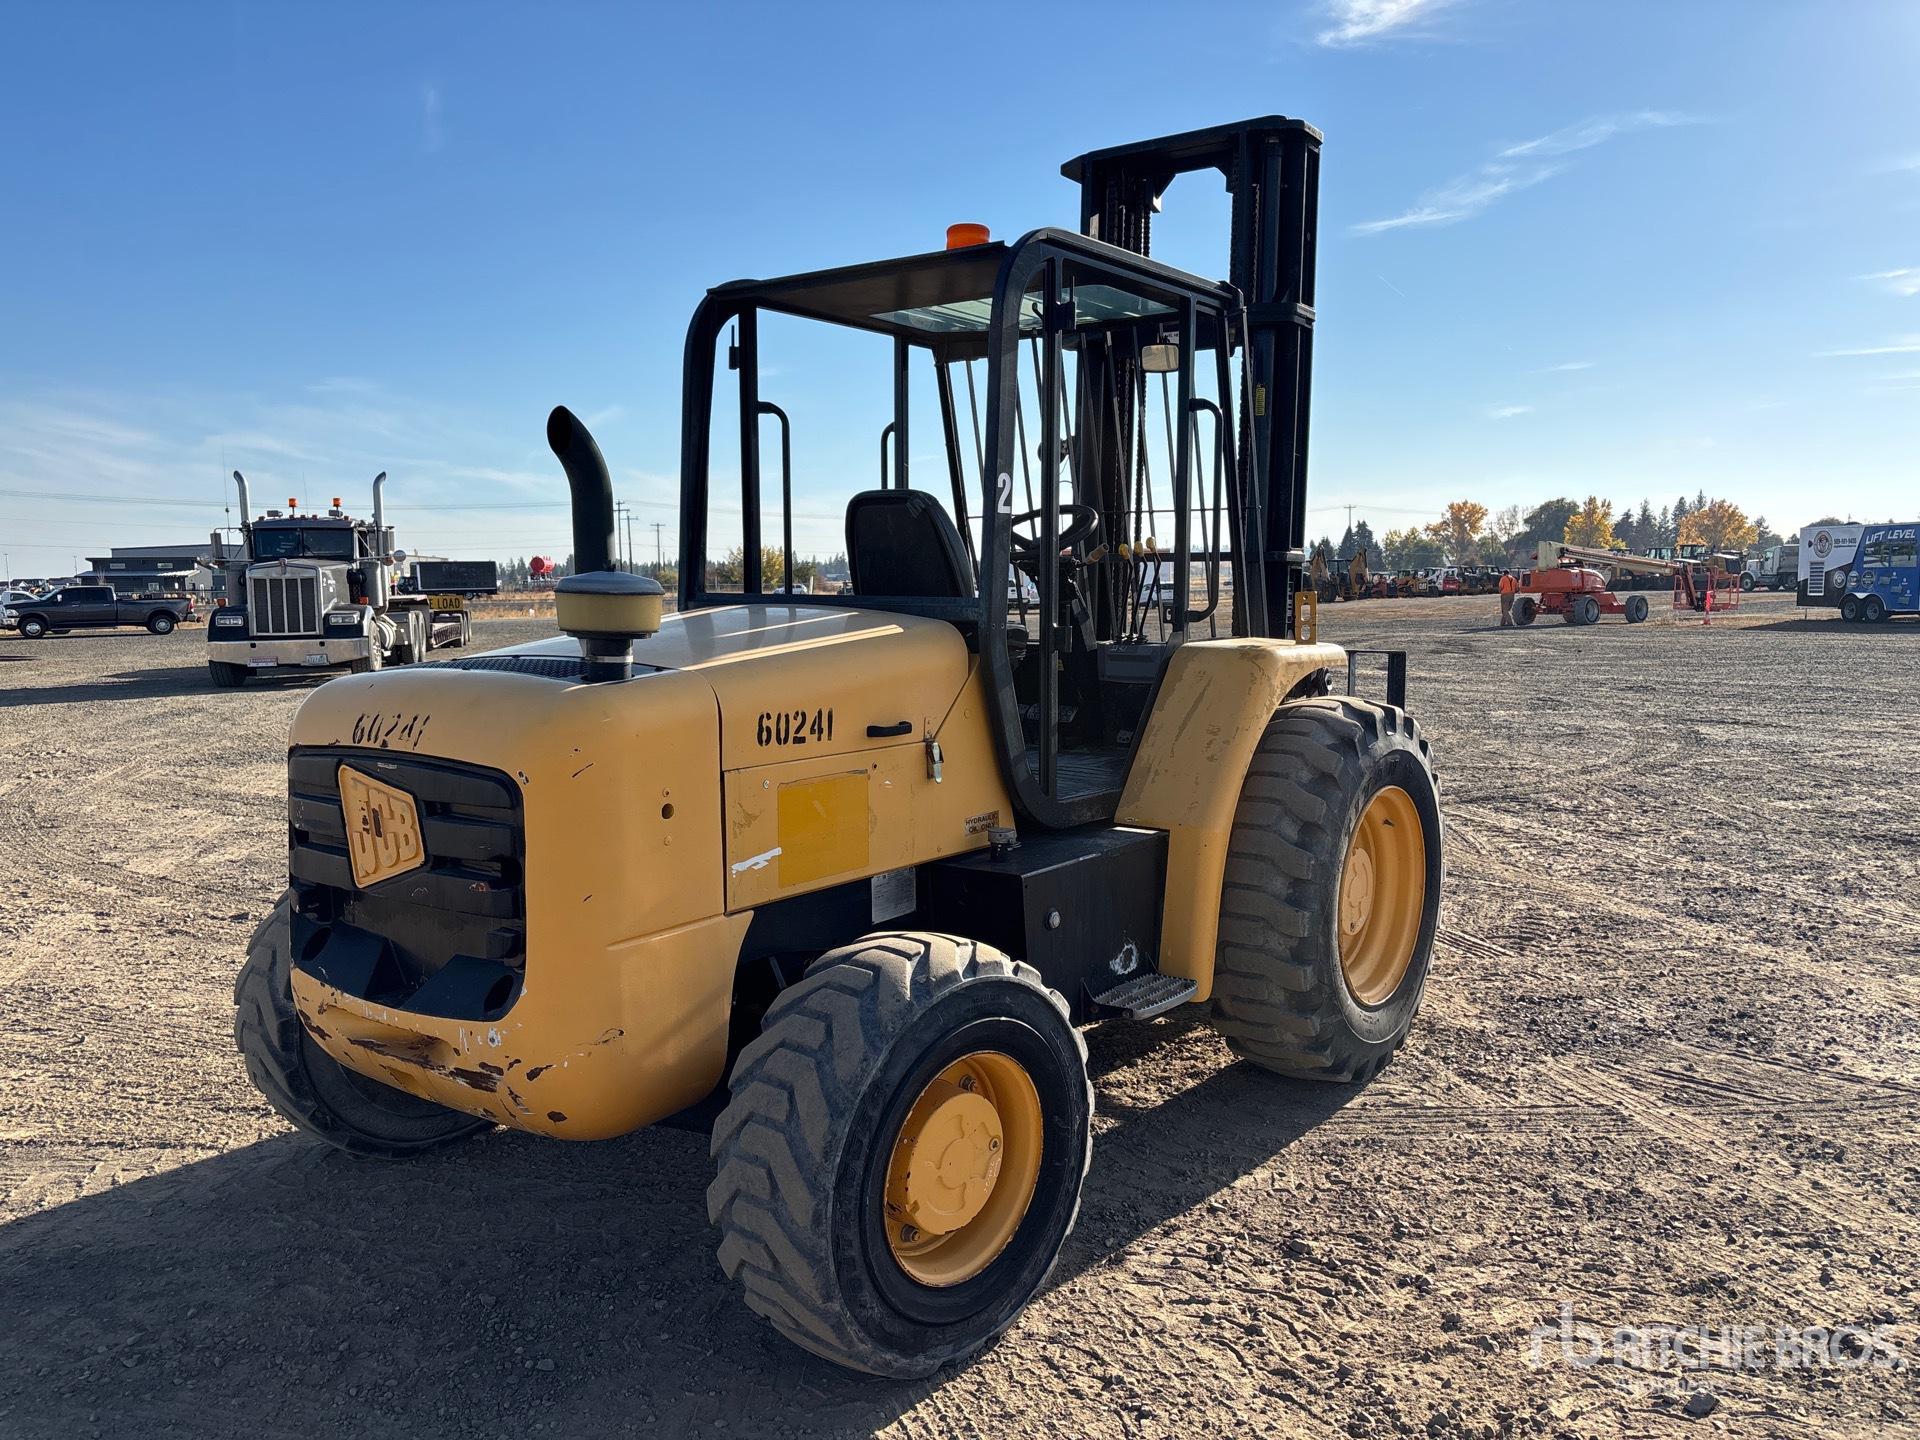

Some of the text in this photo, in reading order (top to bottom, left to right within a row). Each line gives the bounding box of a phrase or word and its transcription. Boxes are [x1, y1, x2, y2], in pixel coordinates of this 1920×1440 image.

[997, 472, 1012, 514] 2
[1866, 529, 1915, 544] LIFT LEVEL
[437, 598, 461, 610] LOAD
[757, 707, 834, 747] 60241
[350, 777, 418, 877] JCB
[966, 813, 998, 825] HYDRAULIC
